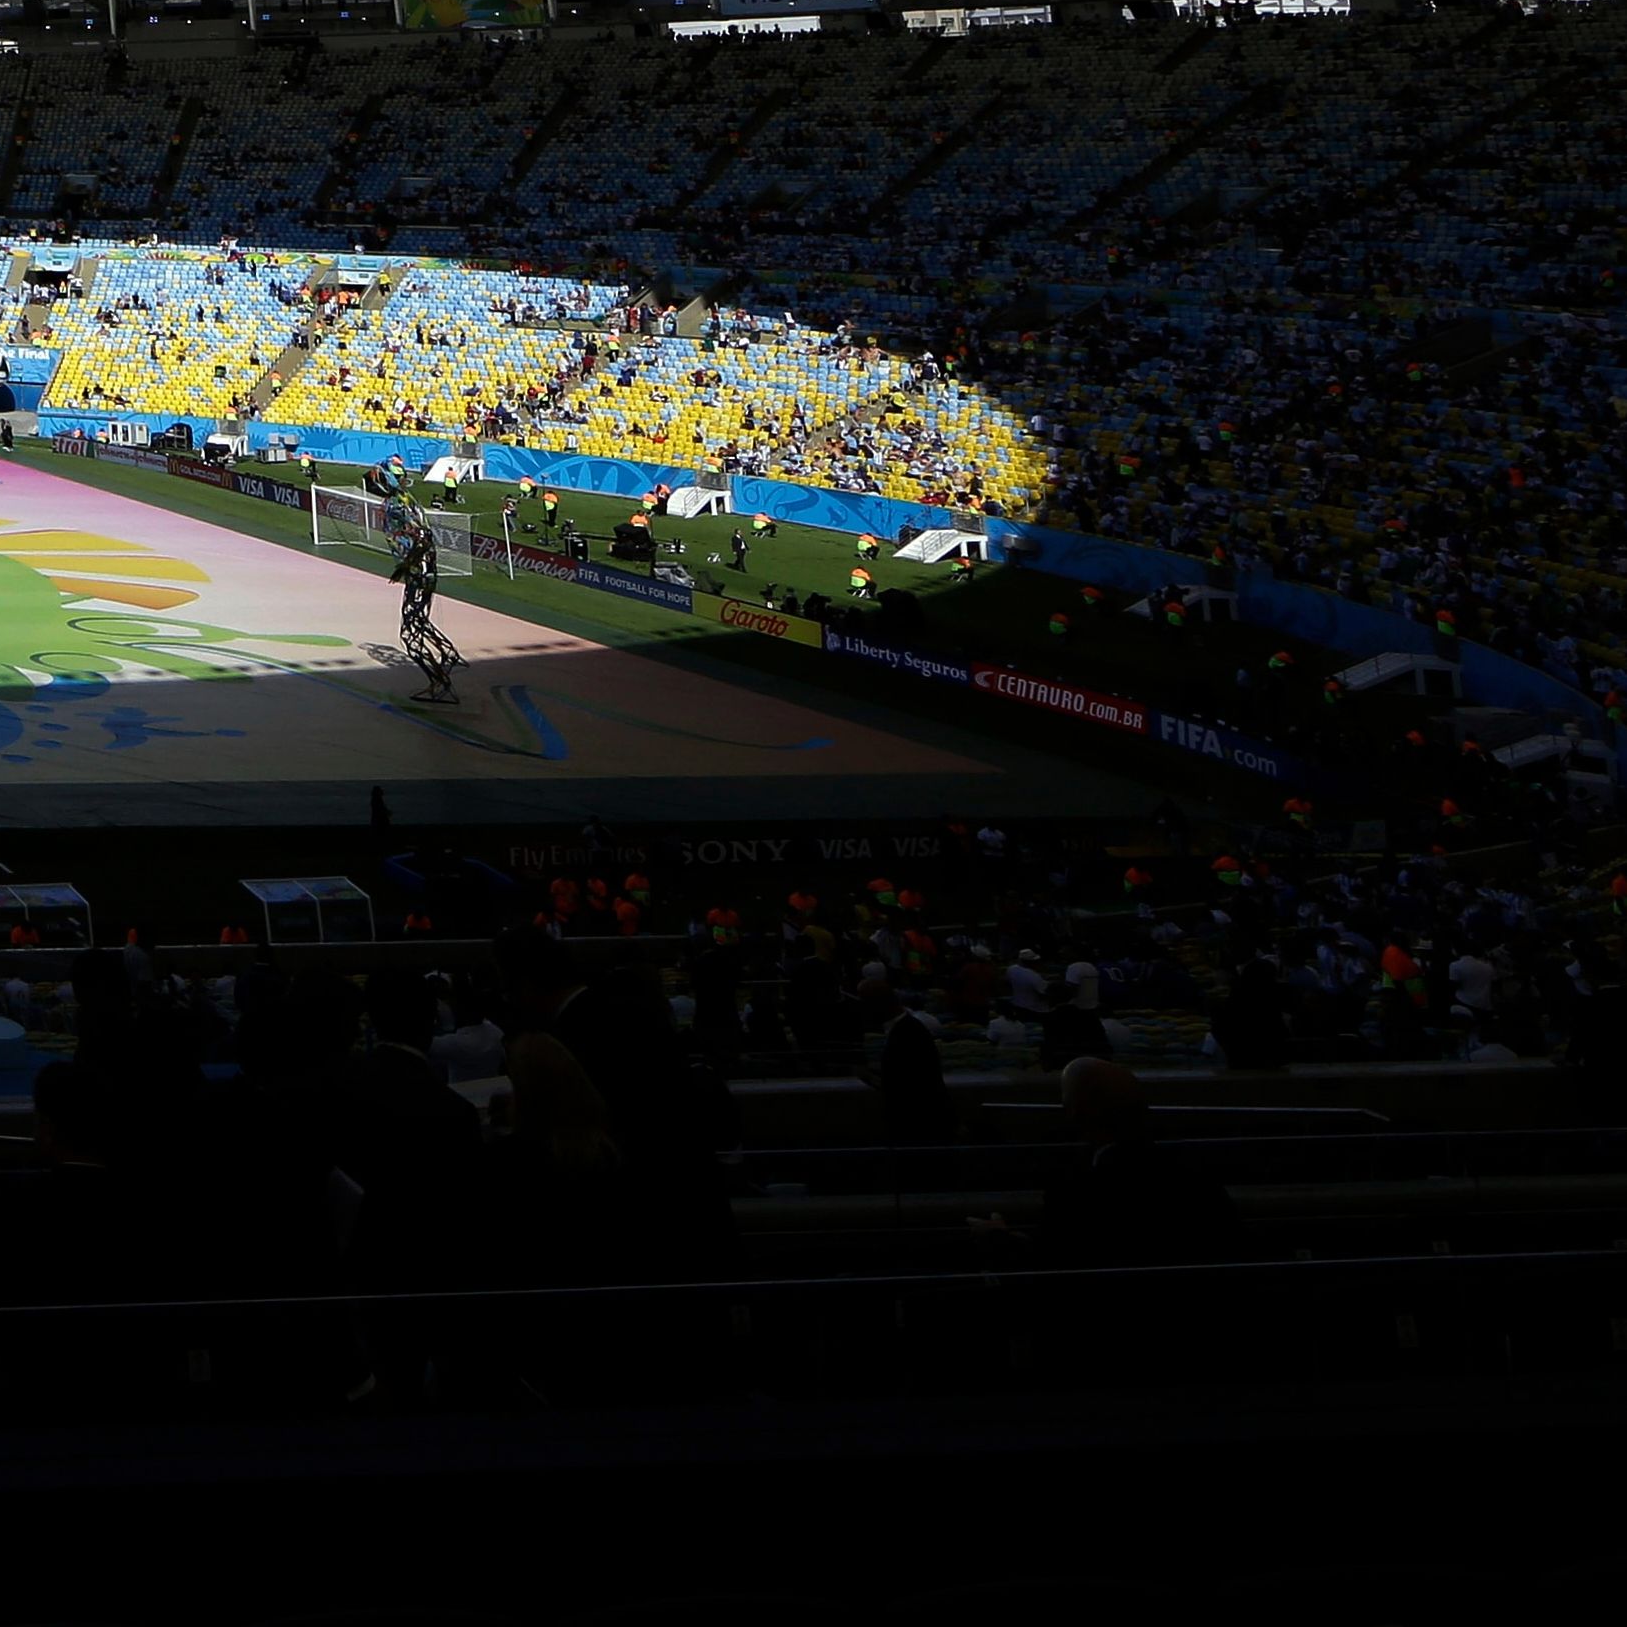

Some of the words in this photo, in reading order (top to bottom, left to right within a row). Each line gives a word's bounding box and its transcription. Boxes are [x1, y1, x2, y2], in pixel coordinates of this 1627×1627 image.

[238, 475, 265, 498] VISA
[272, 484, 301, 508] VISA
[578, 568, 601, 584] FIFA
[605, 576, 648, 595] FOOTBALL
[649, 587, 666, 600] FOR
[667, 591, 691, 607] HOPE
[720, 600, 790, 636] Garoto
[845, 636, 901, 668] Liberty
[904, 651, 969, 681] Seguros
[817, 837, 873, 860] VISA
